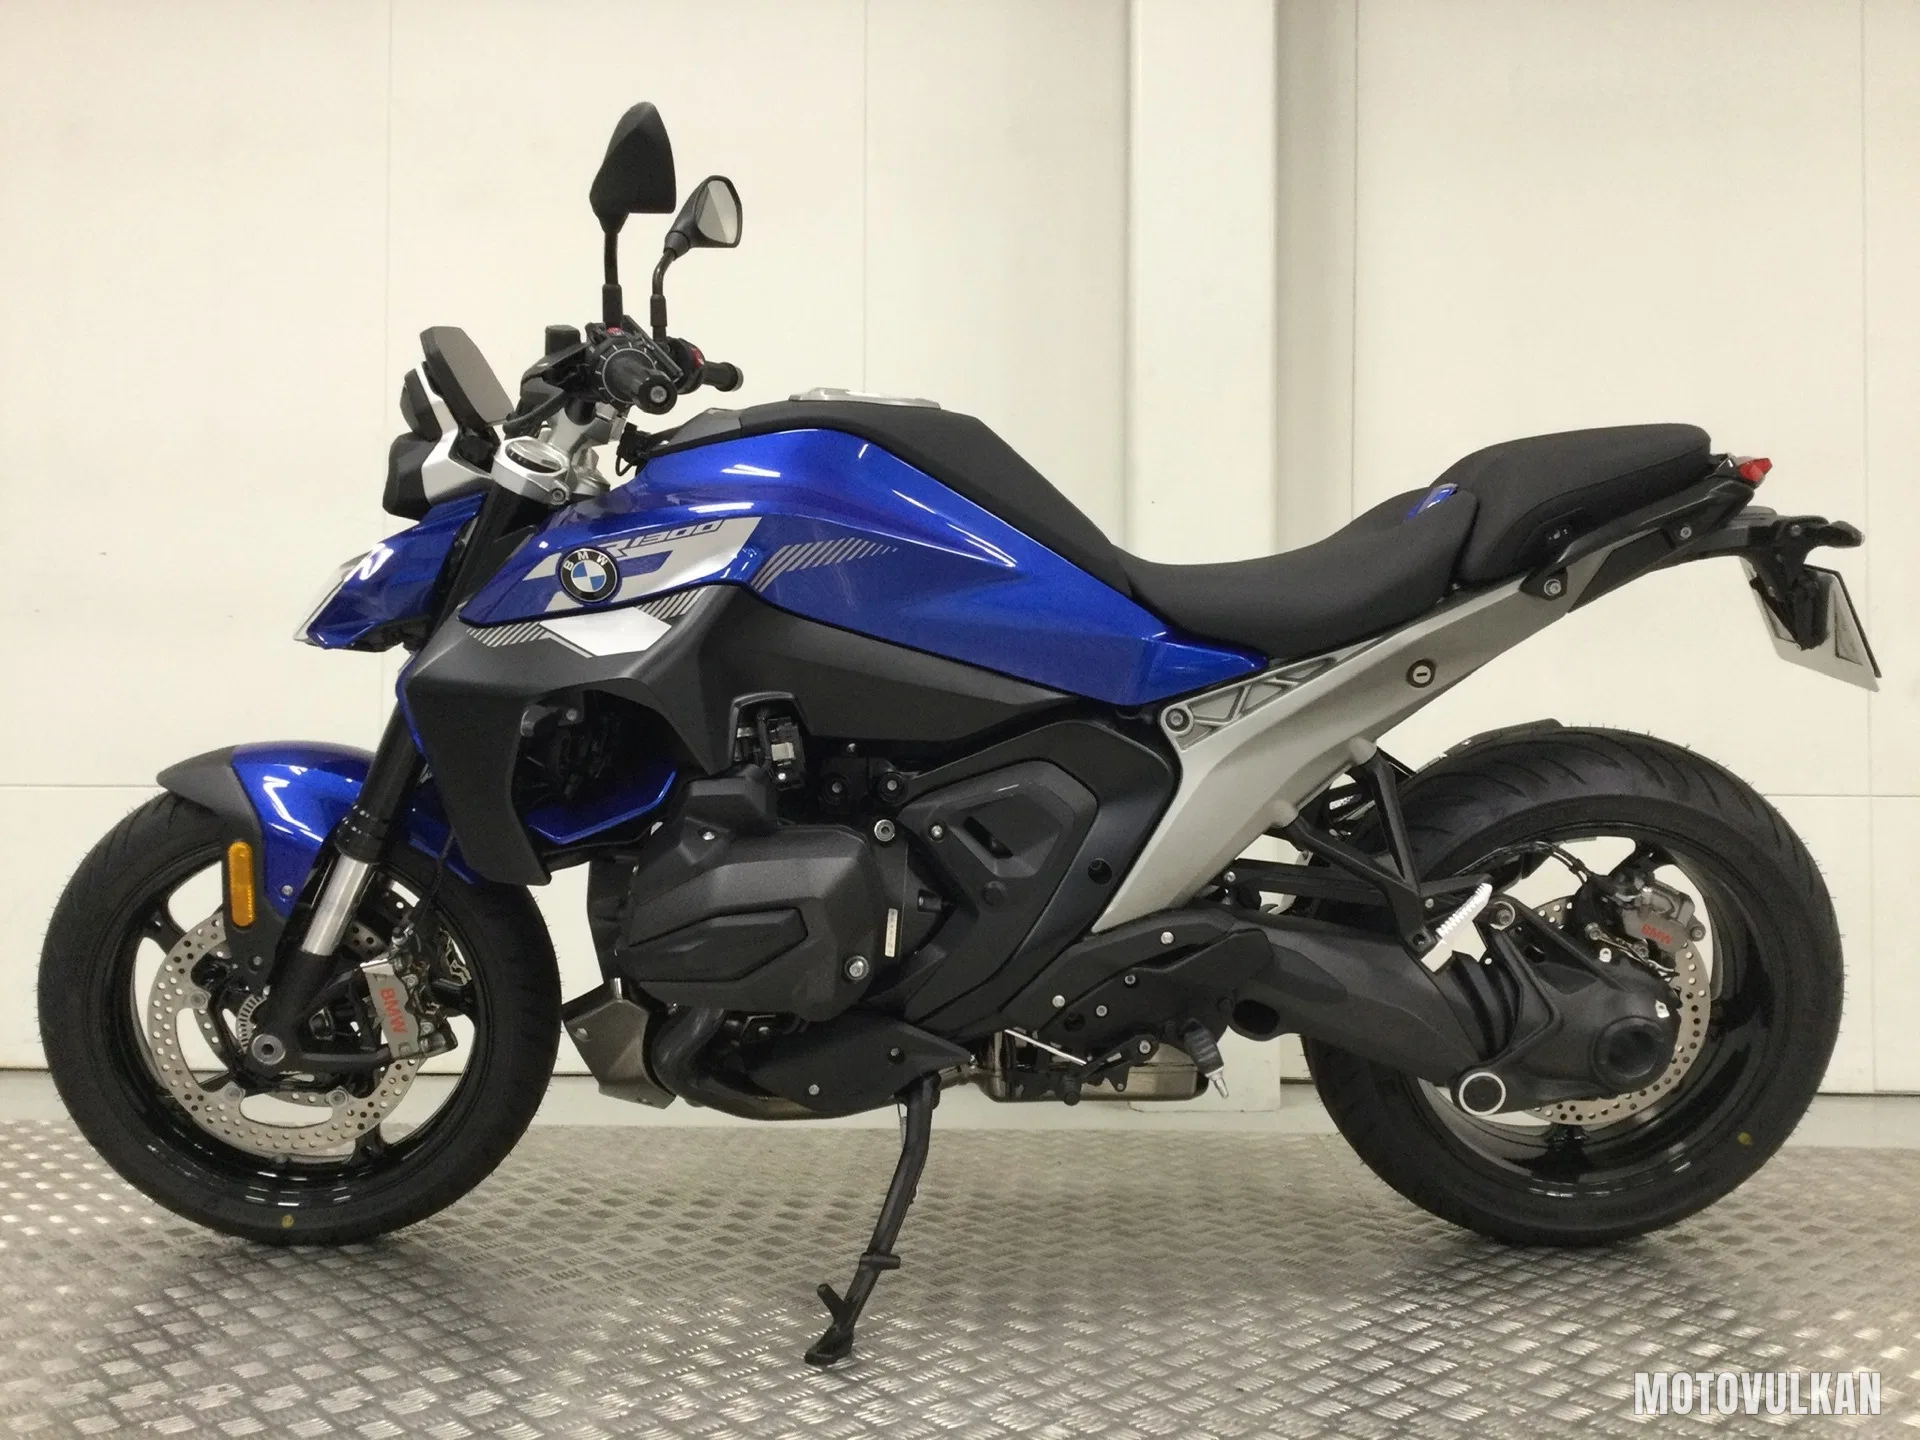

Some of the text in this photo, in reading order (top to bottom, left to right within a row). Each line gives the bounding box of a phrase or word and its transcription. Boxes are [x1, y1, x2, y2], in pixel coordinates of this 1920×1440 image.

[563, 551, 609, 572] BMW
[1641, 924, 1674, 944] BMW
[380, 987, 408, 1034] BMW
